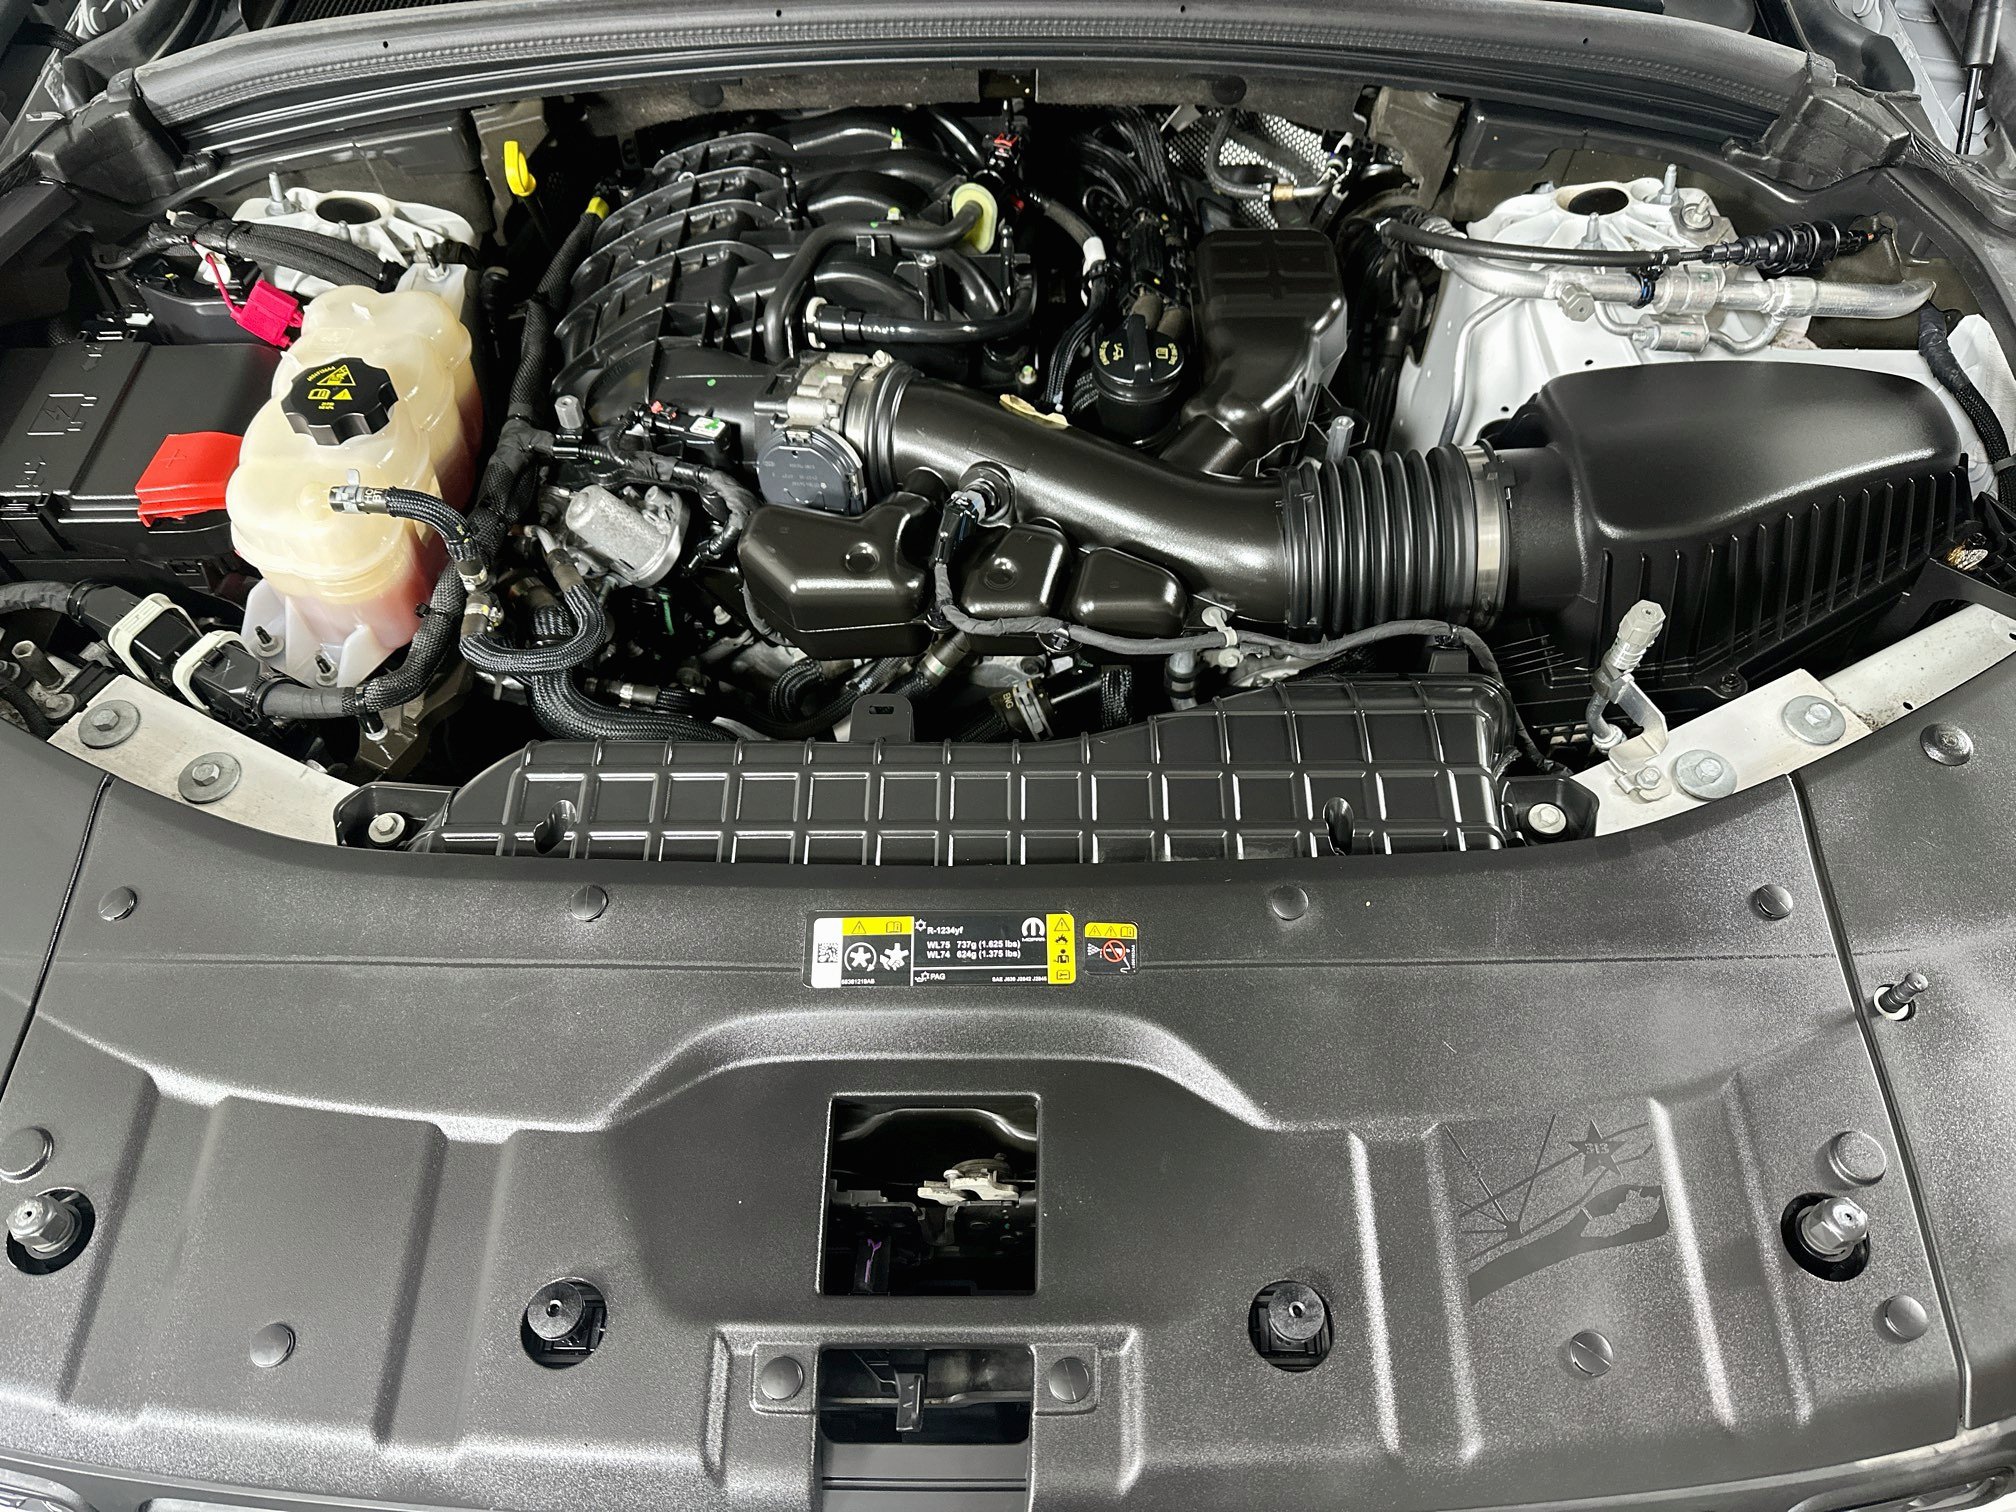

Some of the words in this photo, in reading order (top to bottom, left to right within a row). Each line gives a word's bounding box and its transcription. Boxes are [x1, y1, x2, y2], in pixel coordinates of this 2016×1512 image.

[1003, 692, 1014, 708] ENG
[927, 926, 963, 936] R-1234yf
[927, 941, 951, 949] WL75
[957, 940, 977, 950] 737g
[978, 940, 1004, 949] (1.625
[1005, 939, 1021, 949] lbs)
[927, 950, 951, 958] WL74
[957, 950, 977, 960] 624g
[978, 950, 1004, 959] (1.375
[1005, 949, 1021, 959] lbs)
[1584, 1142, 1610, 1154] 313
